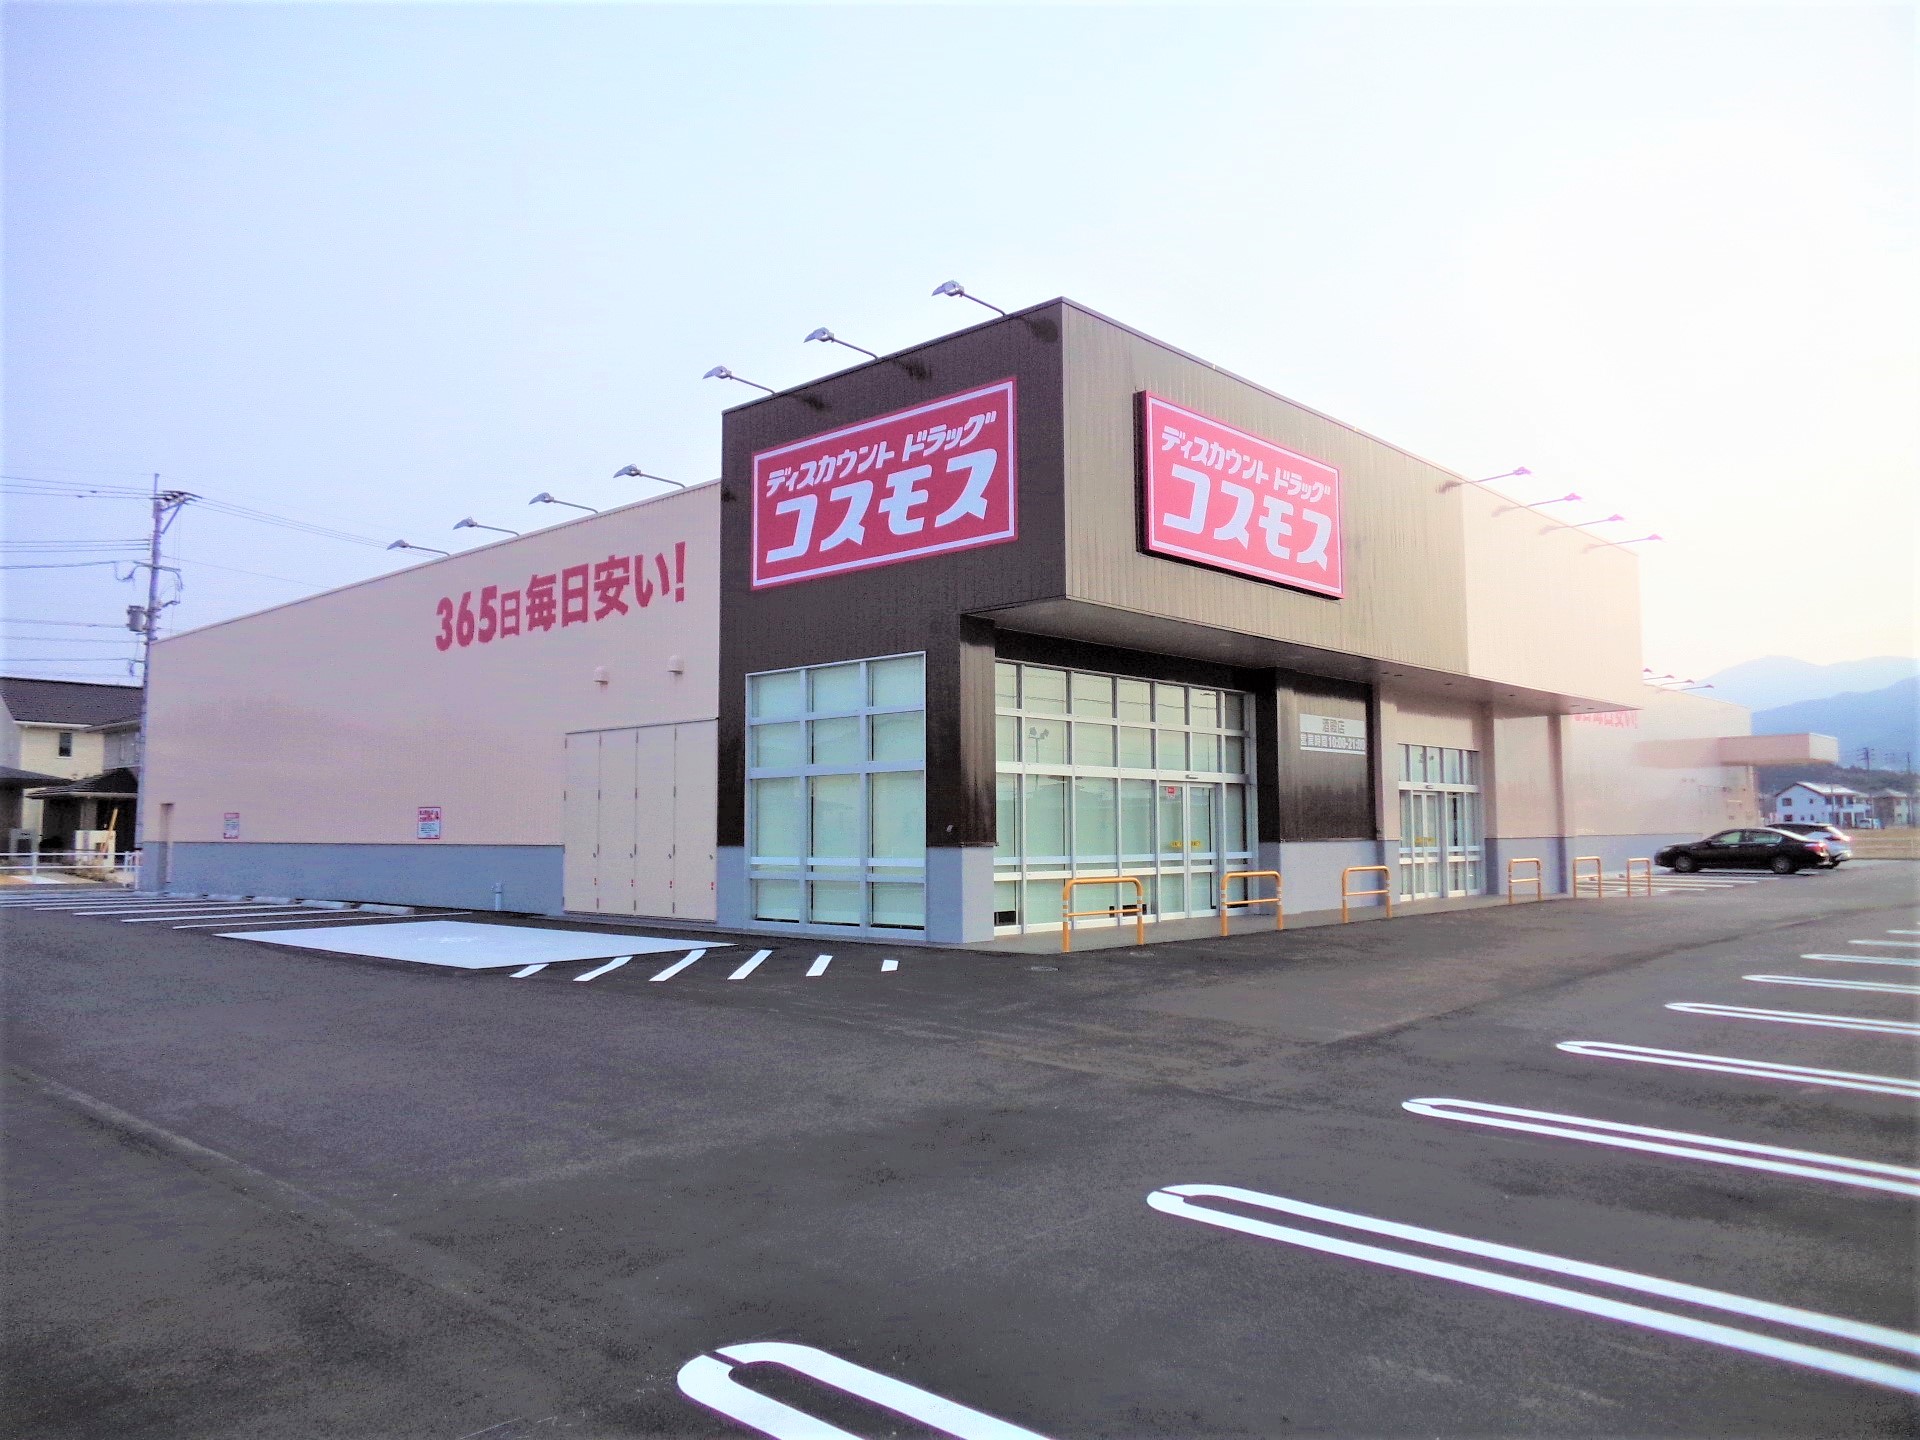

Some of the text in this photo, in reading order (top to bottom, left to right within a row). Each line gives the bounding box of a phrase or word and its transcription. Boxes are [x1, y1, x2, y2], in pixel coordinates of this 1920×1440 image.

[766, 411, 997, 498] ディスカウント ドラッグ
[766, 448, 998, 563] コスモス
[1161, 425, 1331, 503] ディスカウント ドラッグ
[1163, 463, 1332, 571] コスモス
[435, 541, 686, 652] 365日毎日安い!
